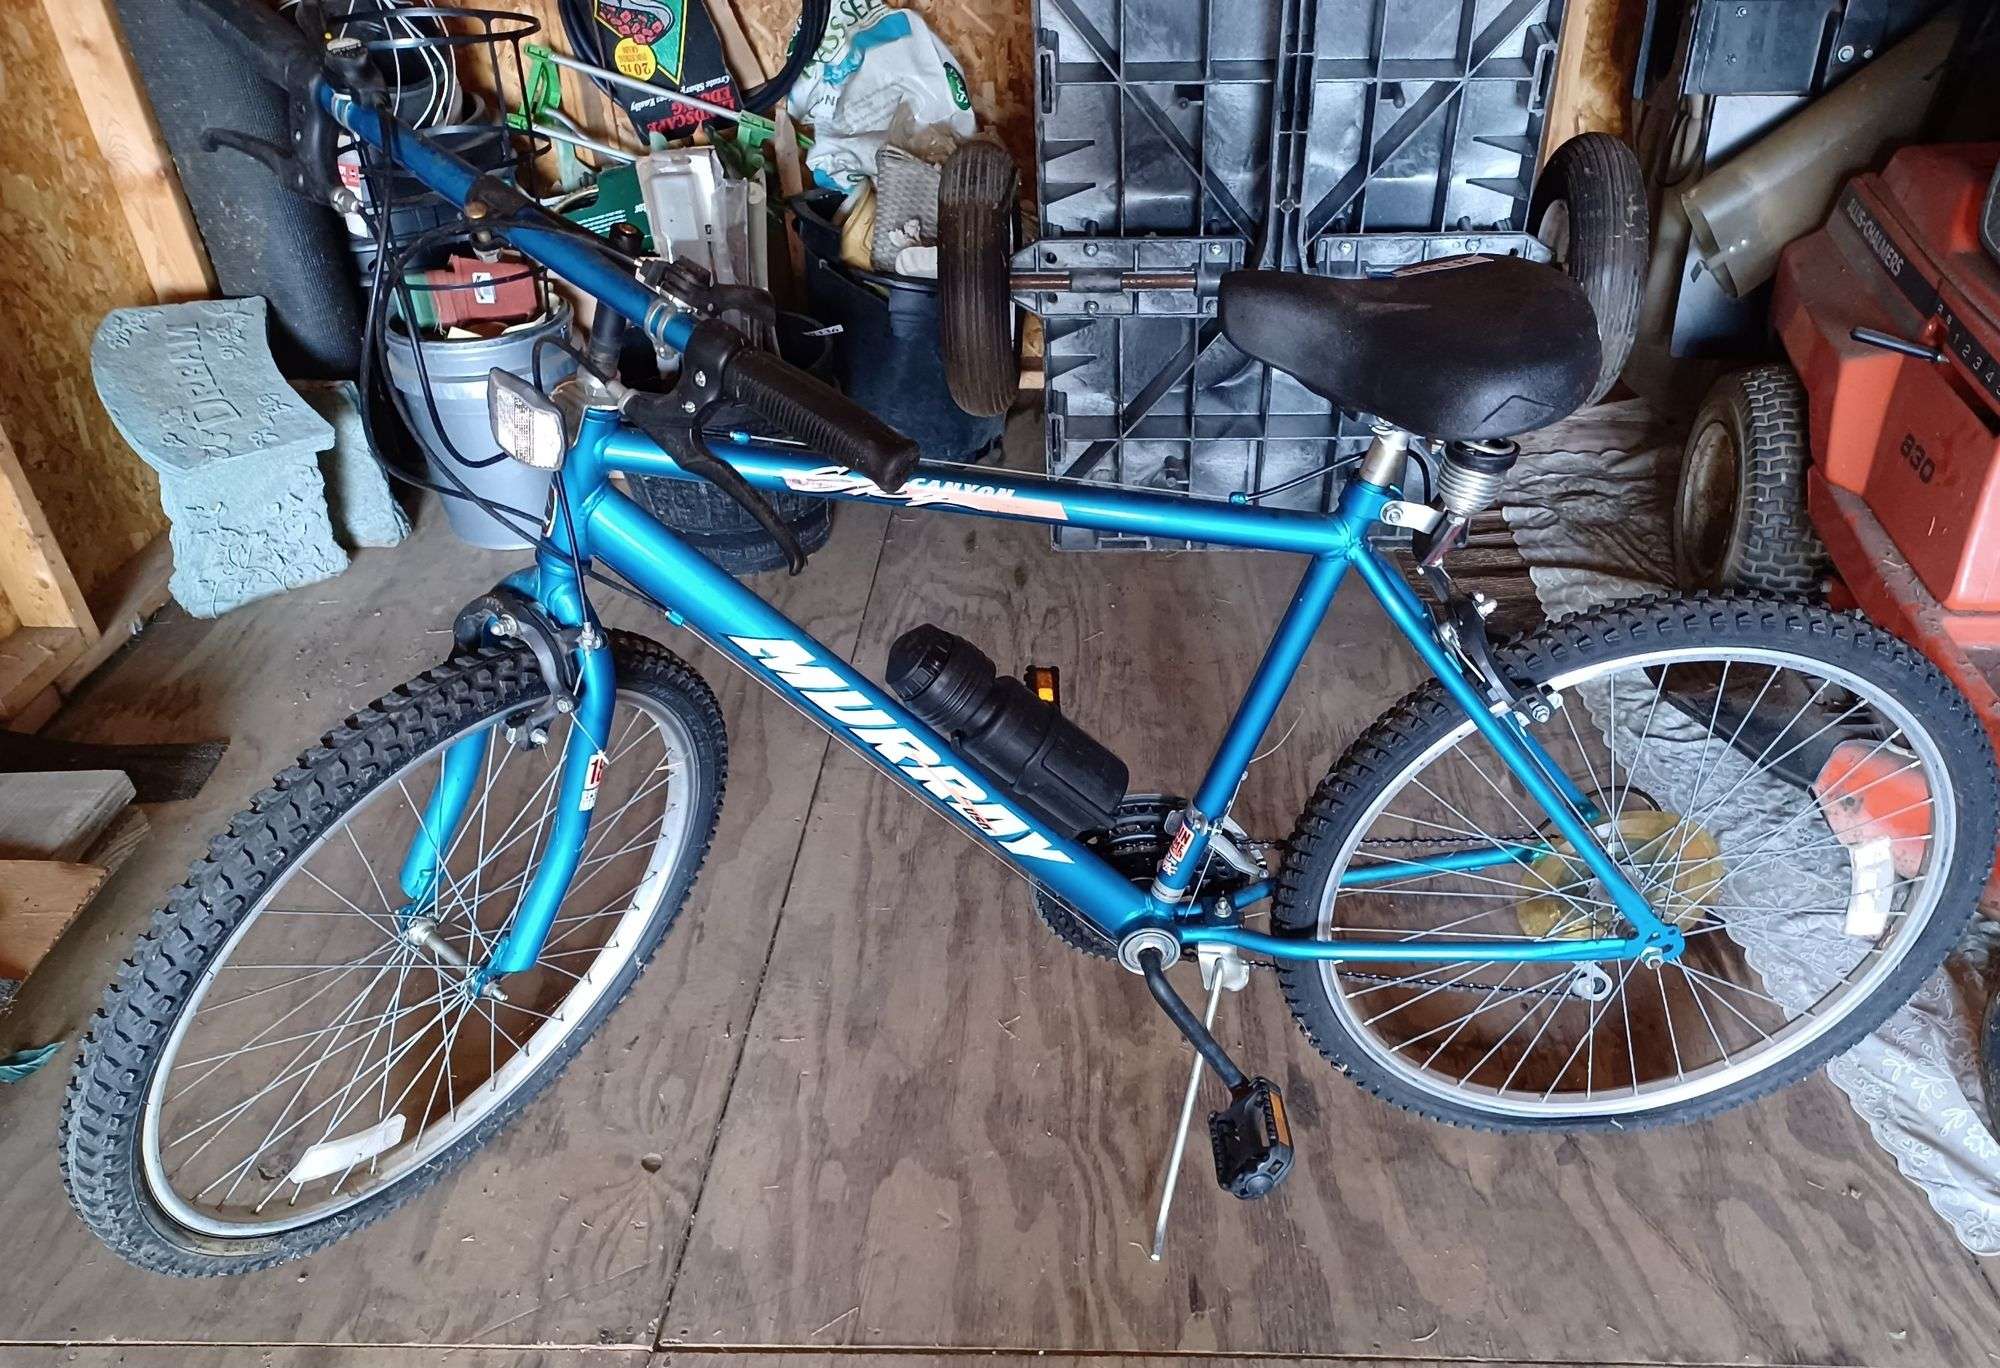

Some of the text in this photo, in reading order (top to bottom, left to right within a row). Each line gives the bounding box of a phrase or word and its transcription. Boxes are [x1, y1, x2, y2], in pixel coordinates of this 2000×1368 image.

[635, 62, 651, 76] 20
[680, 81, 705, 94] Sharp
[705, 75, 731, 90] Create
[630, 96, 657, 112] Easily
[1847, 198, 1905, 278] ALLIS-CHALMERS
[1961, 344, 1971, 358] 2
[1972, 356, 1983, 371] 3
[1985, 371, 1995, 383] 4
[165, 321, 243, 430] DREAM
[907, 477, 1016, 498] CANYON
[727, 635, 1075, 864] MURRAY
